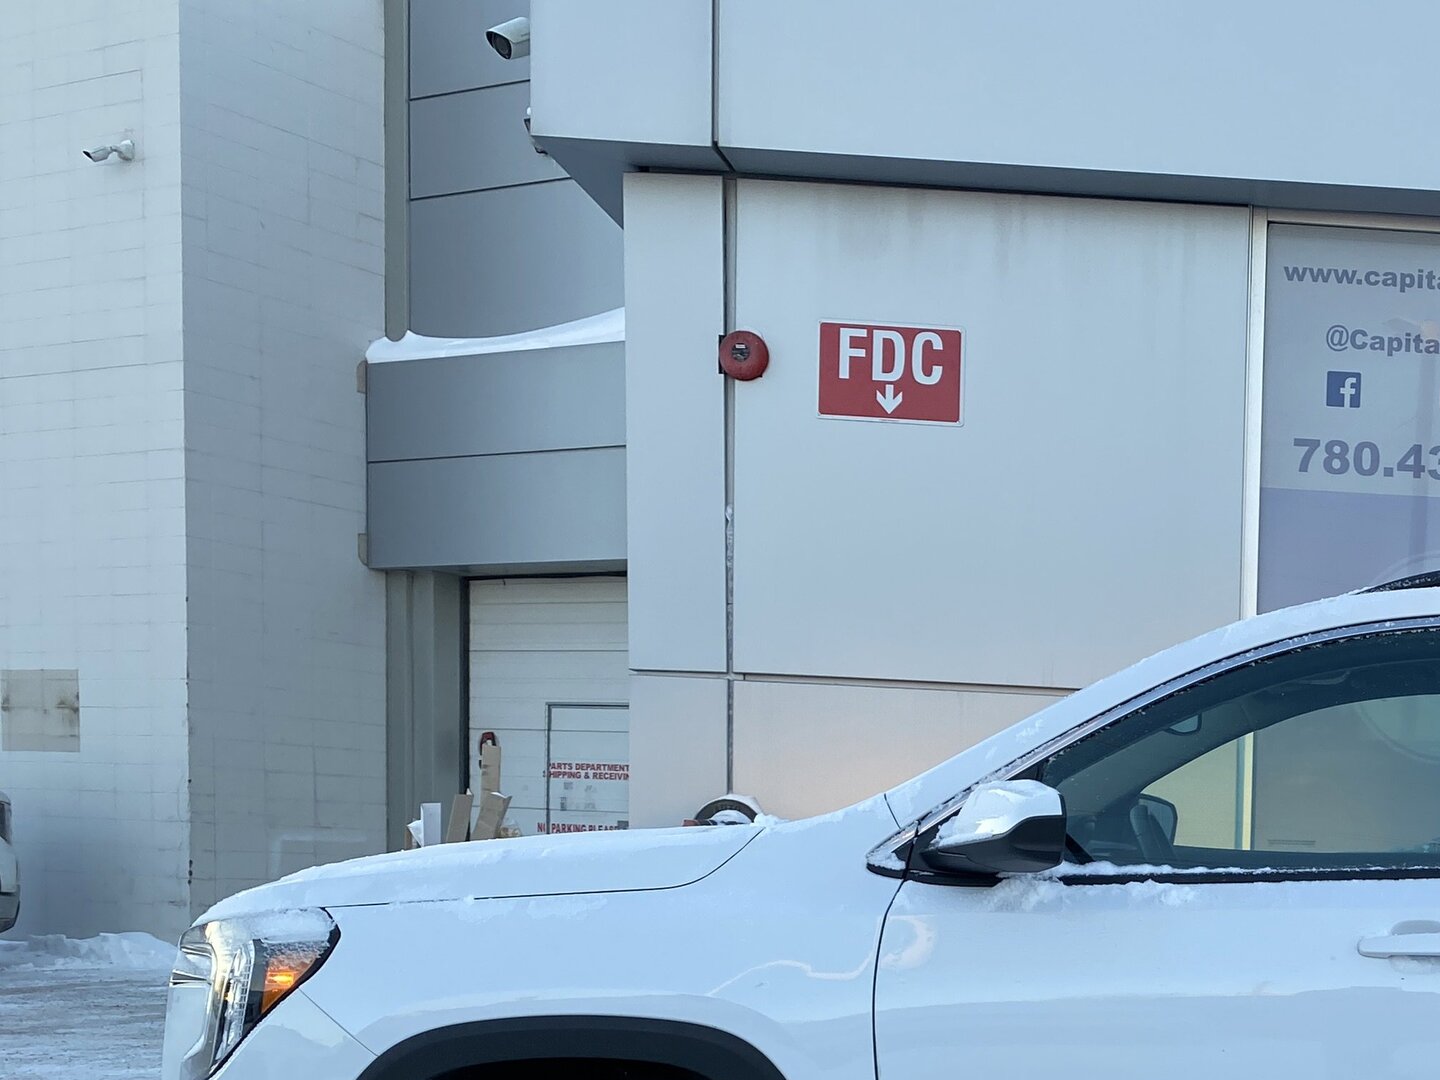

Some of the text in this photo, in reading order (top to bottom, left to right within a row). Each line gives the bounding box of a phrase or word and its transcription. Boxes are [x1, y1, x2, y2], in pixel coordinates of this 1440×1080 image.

[838, 327, 944, 385] FDC
[575, 763, 629, 772] DEPARTMENT
[584, 771, 590, 780] &
[551, 823, 587, 834] PARKING
